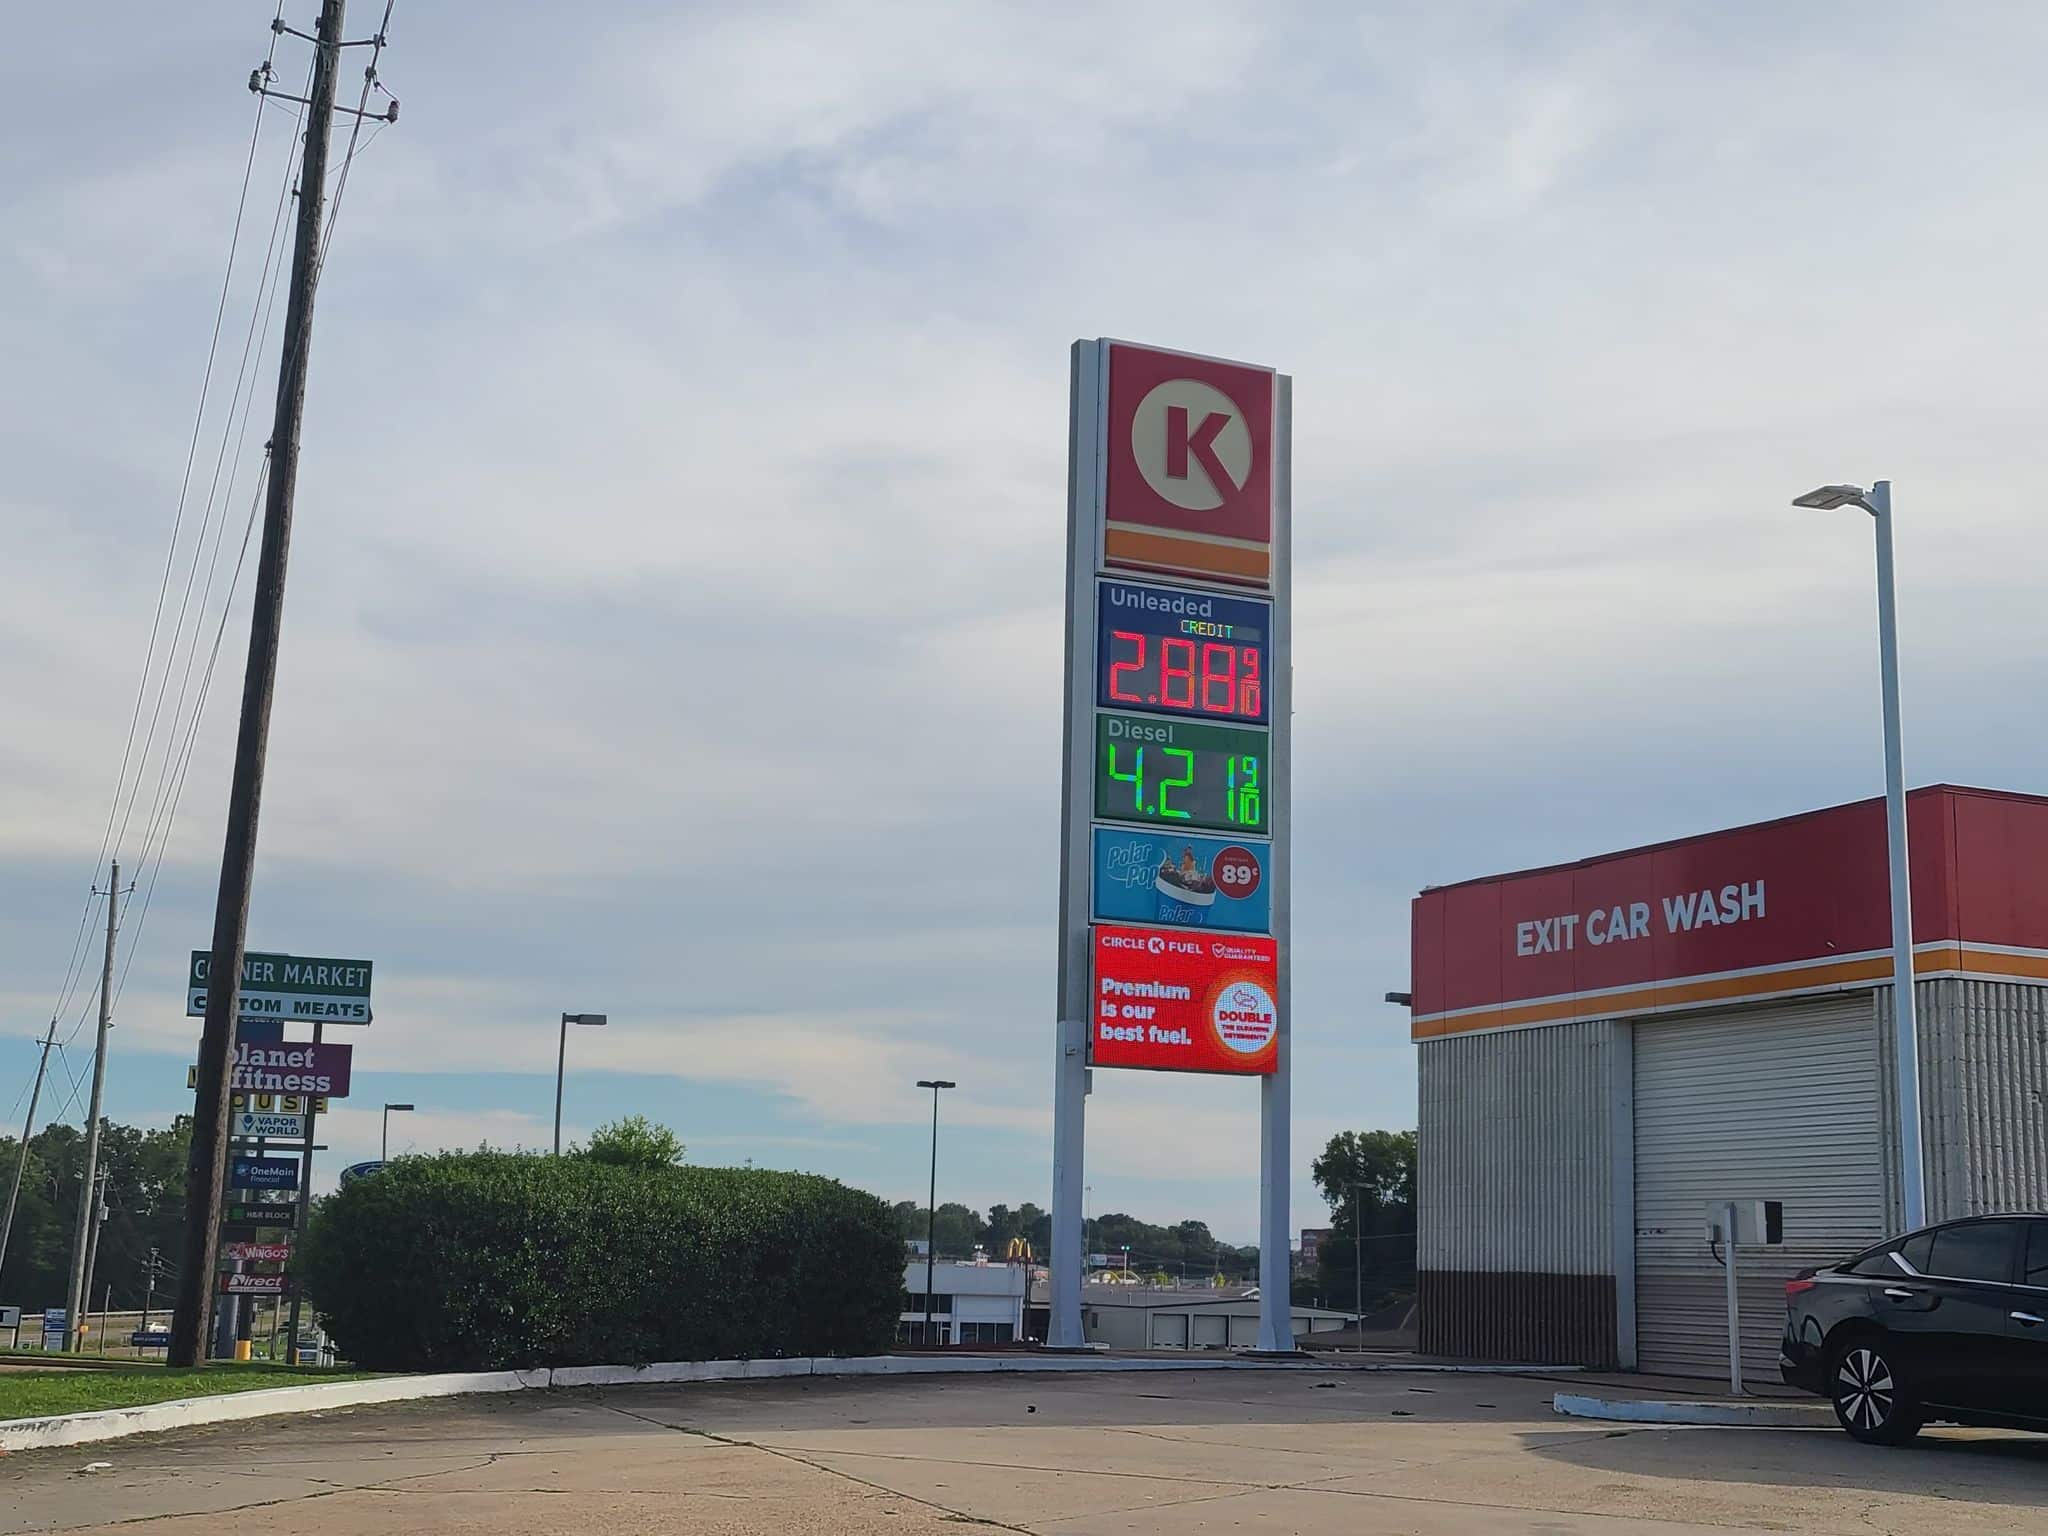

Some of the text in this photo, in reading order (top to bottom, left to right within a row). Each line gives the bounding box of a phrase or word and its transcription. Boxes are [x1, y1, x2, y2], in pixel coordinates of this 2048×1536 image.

[1110, 587, 1213, 618] Unleaded
[1180, 619, 1233, 639] CREDIT
[1108, 719, 1174, 743] Diesel
[1107, 841, 1153, 868] Polar
[1125, 864, 1160, 888] Pop
[1159, 904, 1193, 923] Polar
[1516, 879, 1766, 957] EXIT CAR WASH
[1101, 936, 1145, 951] CIRCLE
[1168, 941, 1203, 955] FUEL
[194, 958, 368, 988] CNER MARKET
[1101, 977, 1191, 1001] Premium
[193, 995, 366, 1017] CTOM MEATS
[1121, 1004, 1156, 1020] our
[1219, 1010, 1272, 1025] DOUBLE
[1100, 1022, 1192, 1046] best fuel.
[231, 1066, 332, 1092] fitness
[255, 1125, 300, 1136] WORLD
[258, 1116, 297, 1128] VAPOR
[250, 1166, 295, 1177] OneMain
[228, 1273, 283, 1288] Direct
